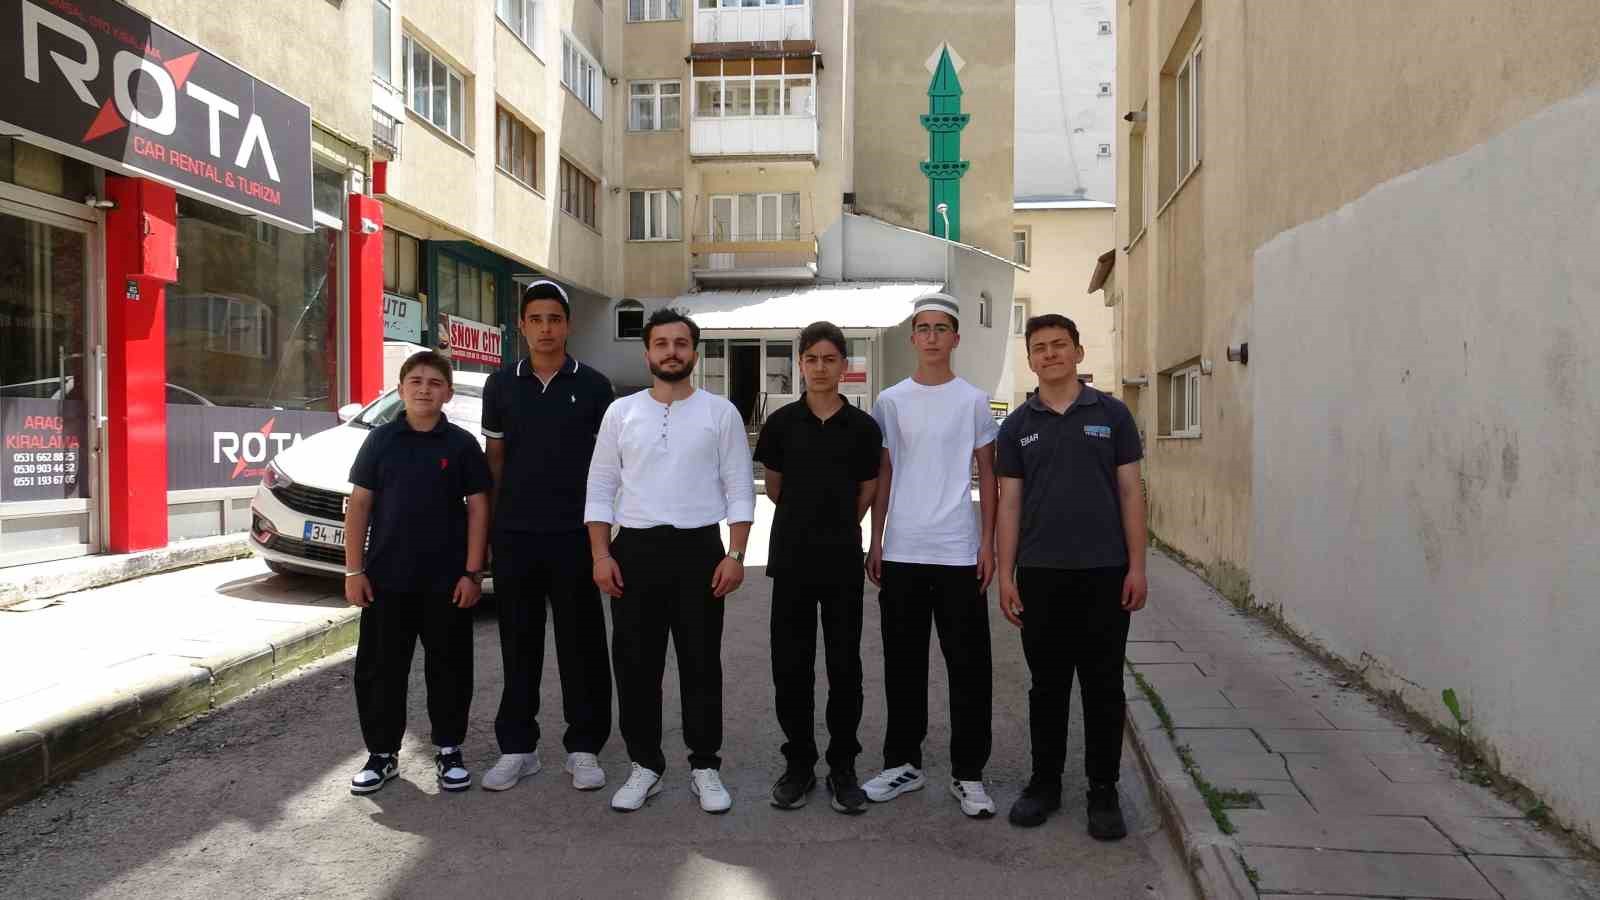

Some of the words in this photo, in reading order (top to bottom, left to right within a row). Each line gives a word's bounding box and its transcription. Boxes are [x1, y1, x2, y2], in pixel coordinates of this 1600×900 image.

[22, 0, 281, 183] ROTA
[133, 136, 165, 161] CAR
[169, 150, 222, 184] RENTAL
[224, 172, 236, 188] &
[384, 297, 407, 318] UTO
[24, 416, 64, 434] ARAÇ
[313, 526, 327, 542] 34
